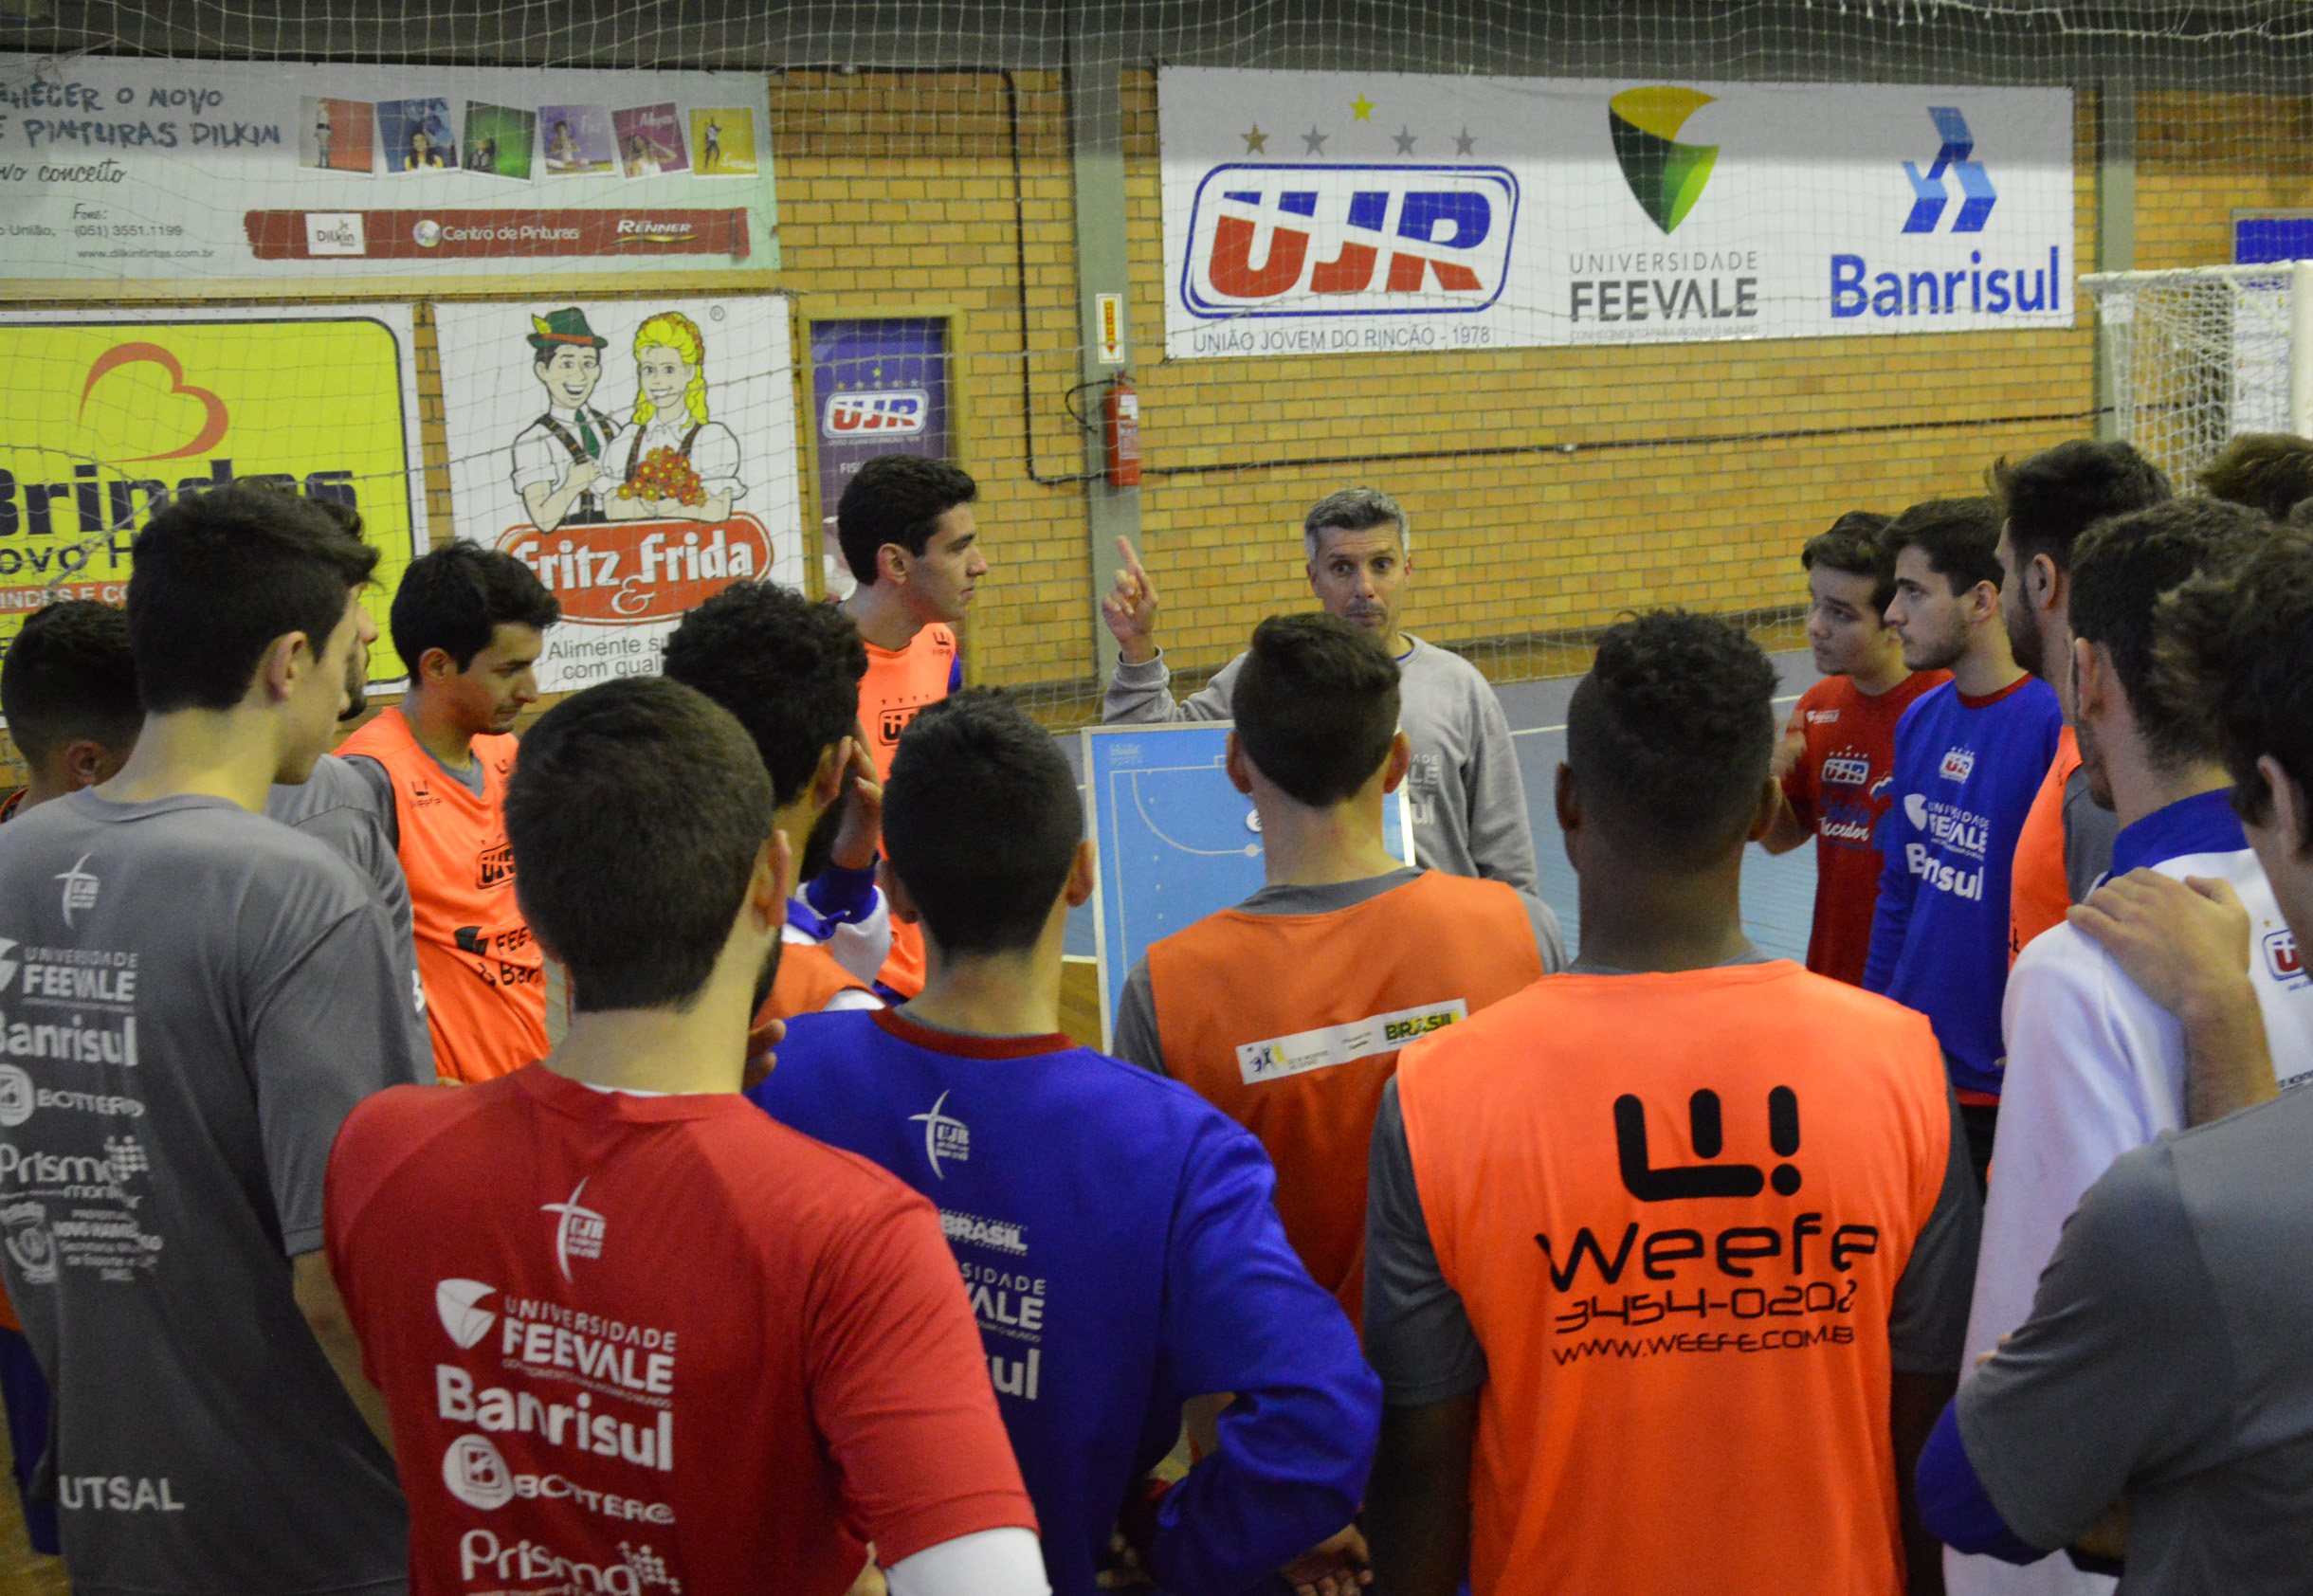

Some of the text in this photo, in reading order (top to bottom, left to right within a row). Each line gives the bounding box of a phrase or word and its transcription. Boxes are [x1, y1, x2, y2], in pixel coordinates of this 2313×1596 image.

[117, 87, 134, 104] O
[148, 86, 225, 115] NOVO
[23, 119, 177, 148] PINTURAS
[191, 122, 282, 147] DILKIN
[38, 157, 127, 183] conceito
[443, 226, 581, 241] Centro de Pinturas
[1570, 250, 1758, 273] UNIVERSIDADE
[1830, 246, 2060, 318] Banrisul
[1570, 277, 1758, 322] FEEVALE
[1193, 329, 1254, 351] UNIÃO
[1260, 330, 1325, 350] JOVEM
[1332, 330, 1359, 348] DO
[1365, 325, 1434, 346] RINCÃO
[1452, 326, 1490, 345] 1978
[639, 530, 755, 584] Frida
[611, 574, 655, 614] &
[548, 638, 641, 660] Alimente
[563, 662, 608, 680] com
[1534, 1212, 1880, 1293] Weefe
[504, 1295, 677, 1352] UNIVERSIDADE
[502, 1316, 675, 1394] FEEVALE
[436, 1364, 673, 1471] Banrisul
